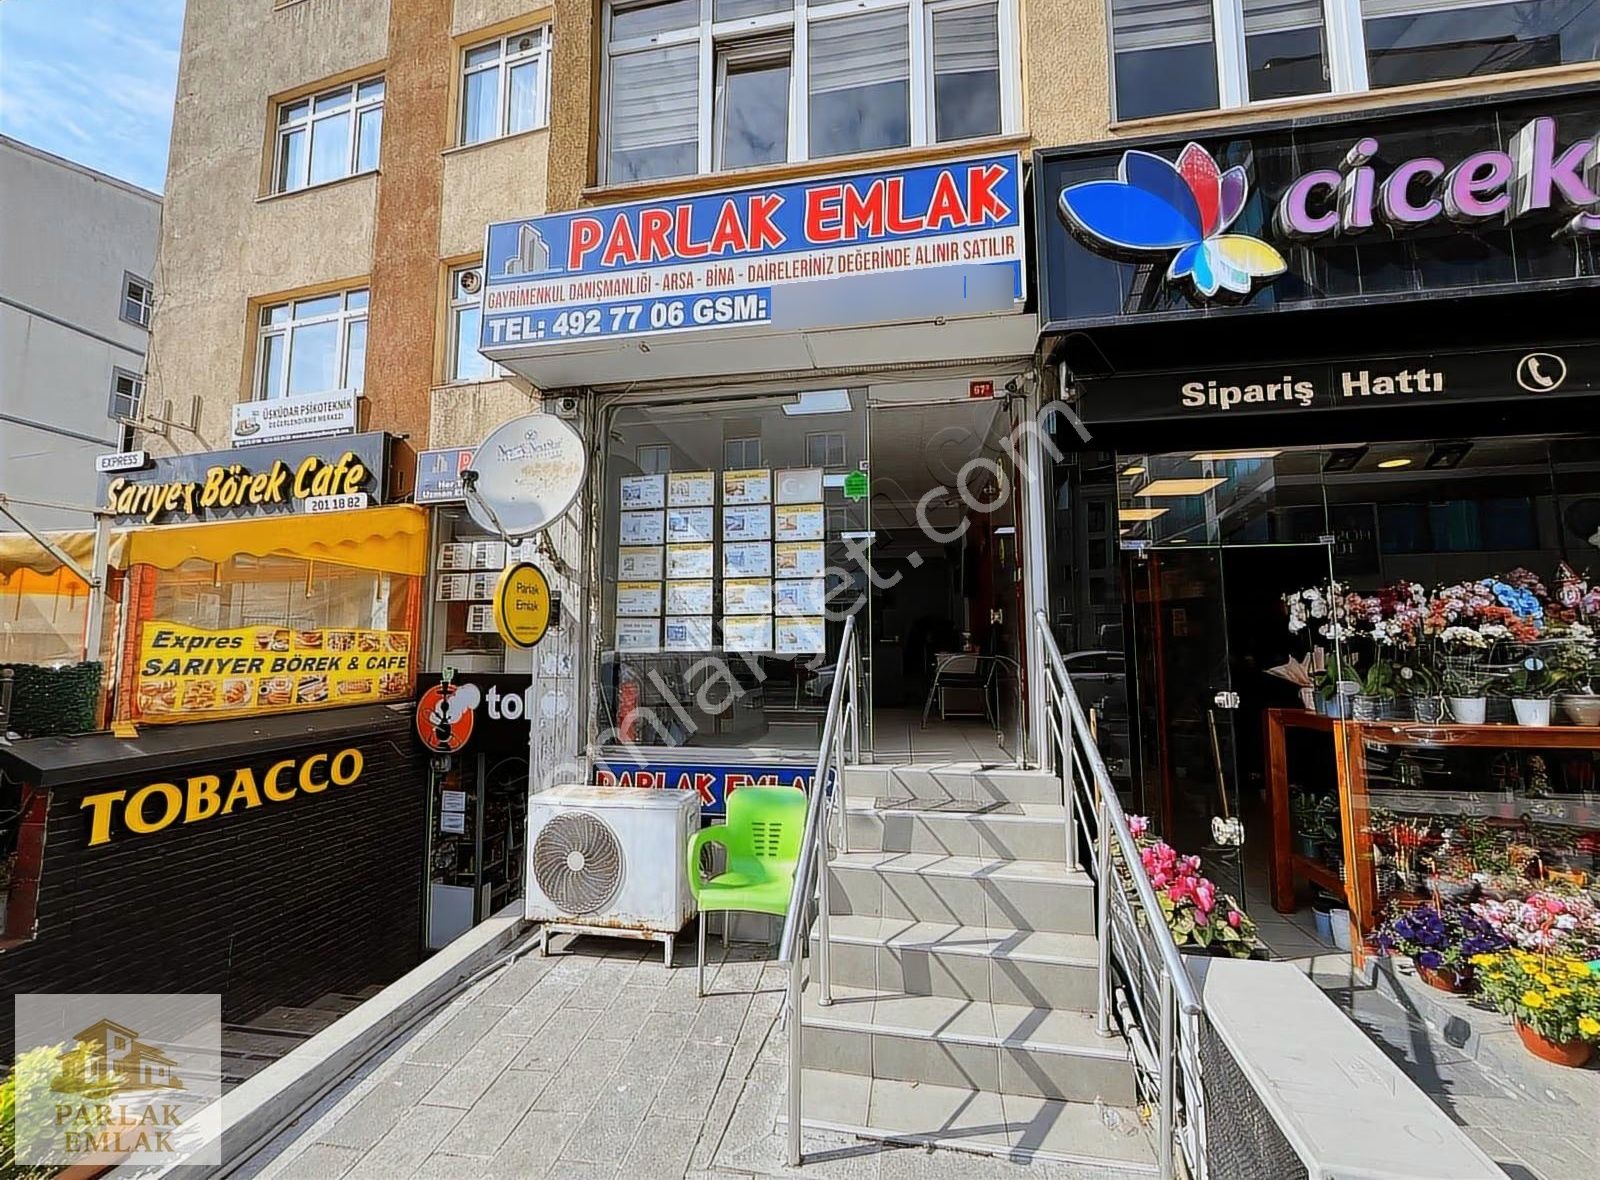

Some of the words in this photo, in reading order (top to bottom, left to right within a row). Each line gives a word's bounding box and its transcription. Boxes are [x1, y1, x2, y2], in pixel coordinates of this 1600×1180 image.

[1276, 115, 1600, 238] cicek
[567, 193, 787, 272] PARLAK
[804, 163, 1012, 244] EMLAK
[488, 286, 565, 309] GAYRİMENKUL
[569, 272, 651, 301] DANIŞMANLIĞI
[662, 271, 694, 291] ARSA
[706, 264, 735, 287] BİNA
[748, 252, 834, 283] DAİRELERİNİZ
[838, 246, 911, 273] DEĞERİNDE
[915, 242, 960, 266] ALINIR
[963, 235, 1015, 260] SATILIR
[488, 316, 545, 342] TEL:
[552, 309, 601, 336] 492
[610, 305, 643, 331] 77
[650, 301, 685, 328] 06
[693, 294, 767, 324] GSM:
[1181, 375, 1315, 410] Sipariş
[1341, 368, 1443, 397] Hattı
[101, 454, 139, 469] EXPRESS
[199, 463, 287, 507] Börek
[293, 451, 365, 499] Cafe
[312, 500, 328, 511] 201
[347, 496, 360, 508] 82
[515, 599, 538, 612] Emlak
[516, 582, 539, 595] Parlak
[152, 630, 244, 653] Expres
[141, 658, 264, 676] SARIYER
[270, 654, 342, 672] BÖREK
[346, 656, 360, 670] &
[365, 656, 407, 670] CAFE
[79, 748, 364, 846] TOBACCO
